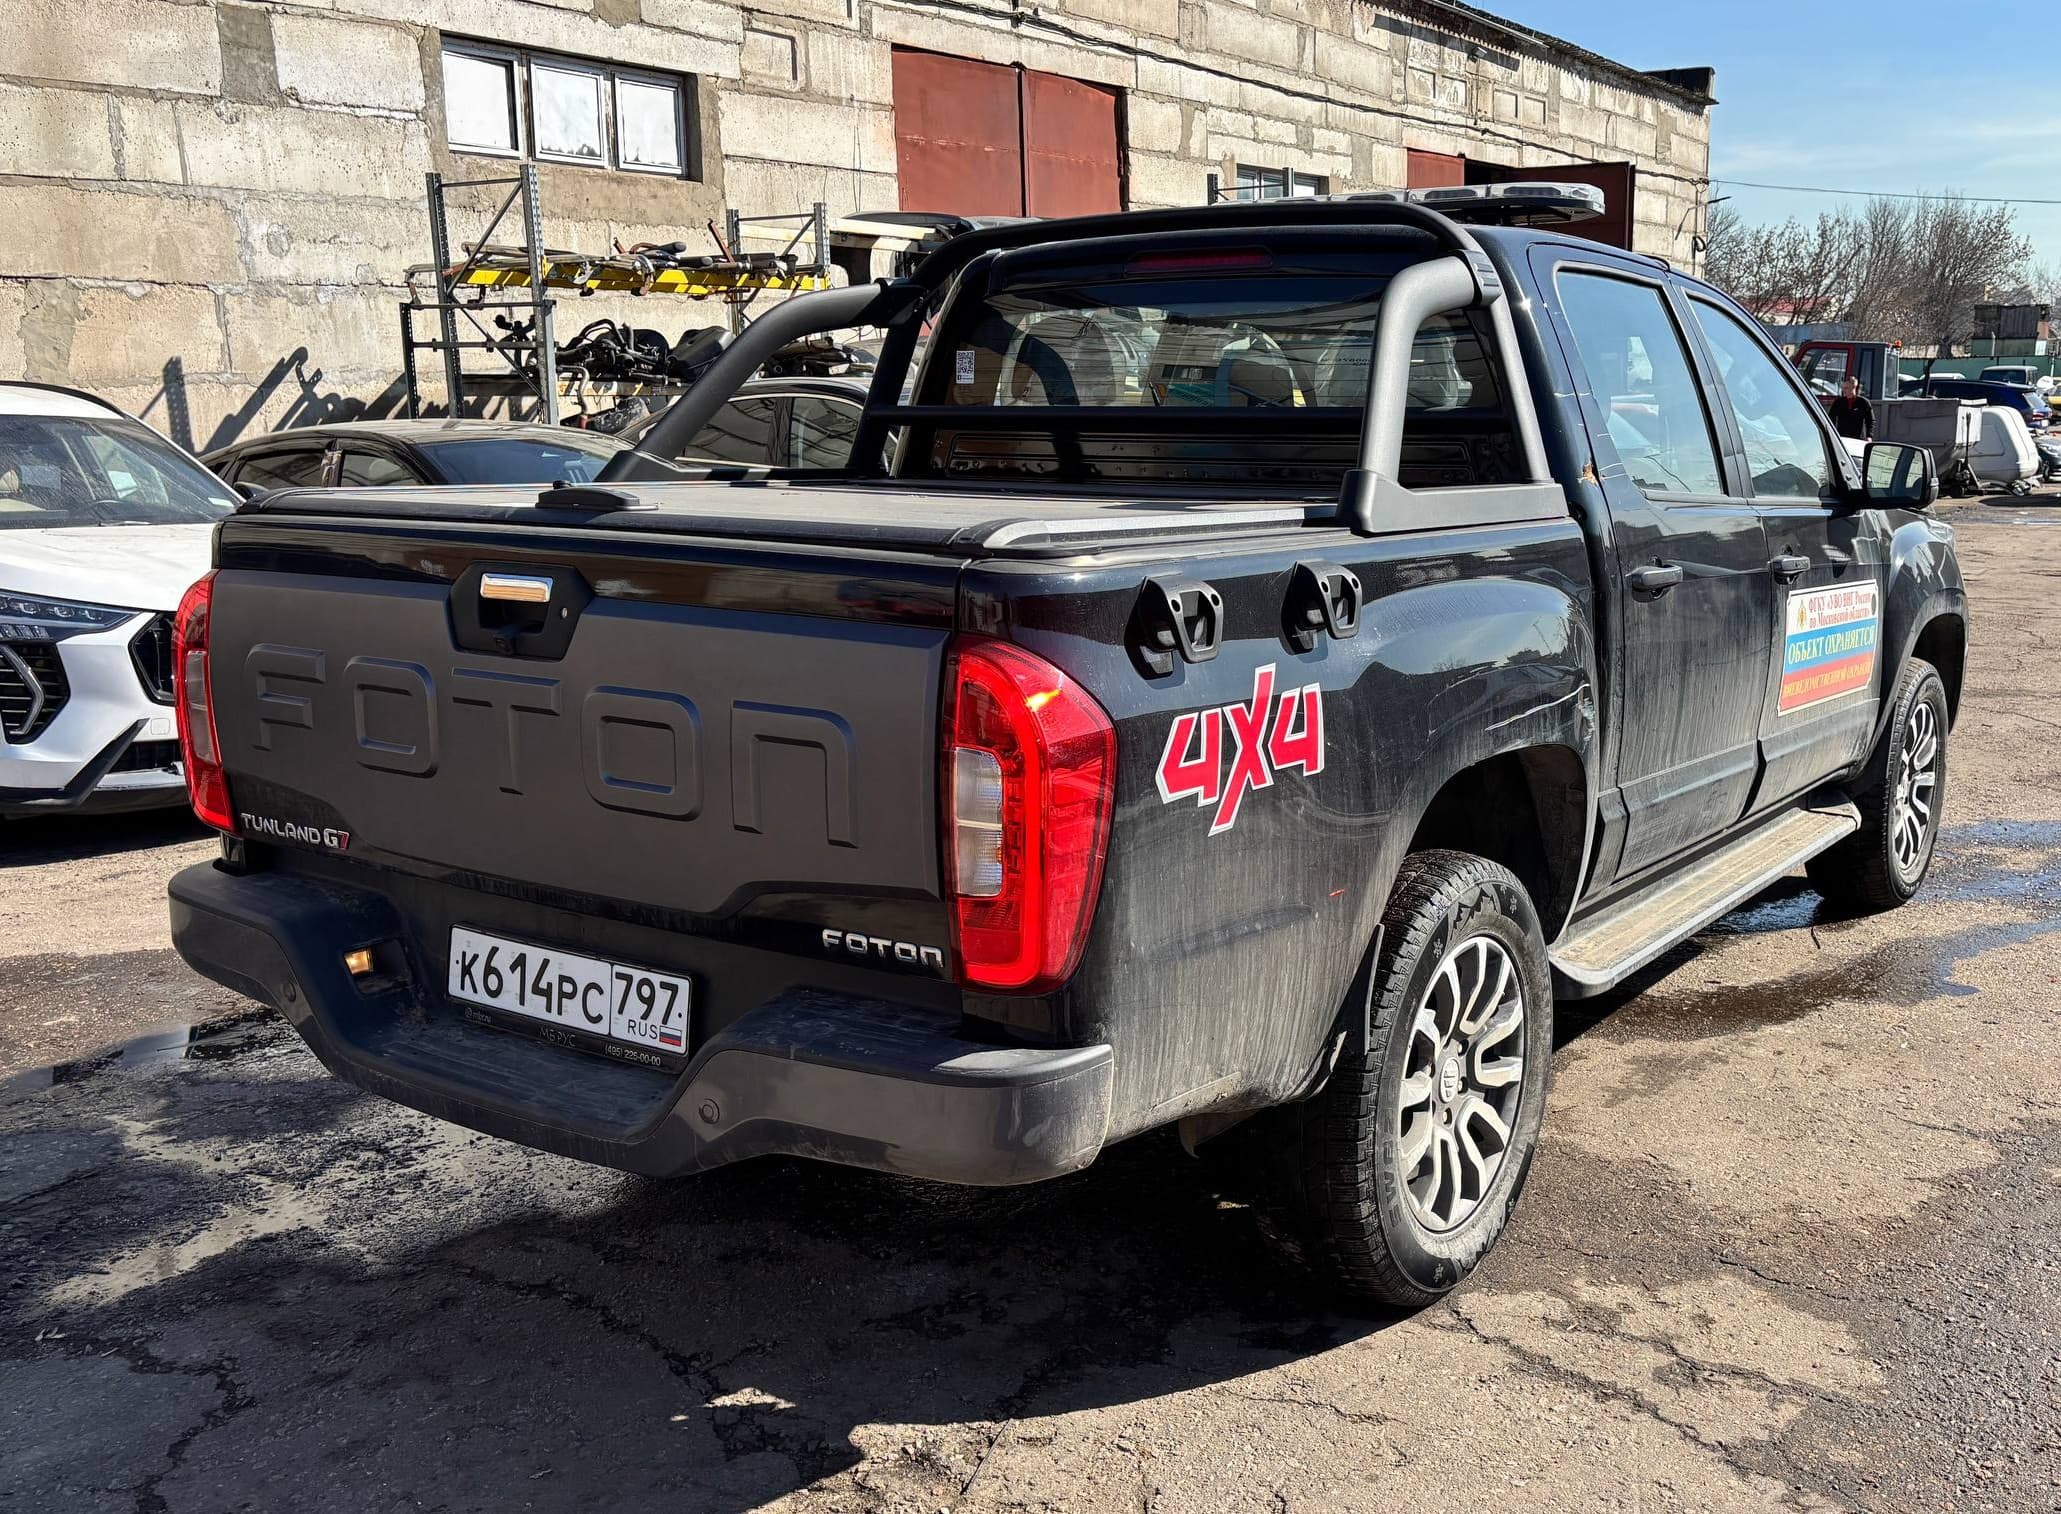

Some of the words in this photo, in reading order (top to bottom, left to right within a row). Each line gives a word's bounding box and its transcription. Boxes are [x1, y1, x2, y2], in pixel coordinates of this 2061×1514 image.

[1788, 636, 1825, 665] ОБЪЕКТ
[1825, 625, 1875, 655] ОХРАНЯЕТСЯ
[246, 643, 861, 849] FOTON
[240, 812, 321, 845] TUNLAND
[323, 828, 350, 850] G7
[822, 928, 944, 968] FOTON
[614, 972, 679, 1026] 797
[627, 1019, 658, 1040] RUS
[604, 1043, 623, 1057] (495)
